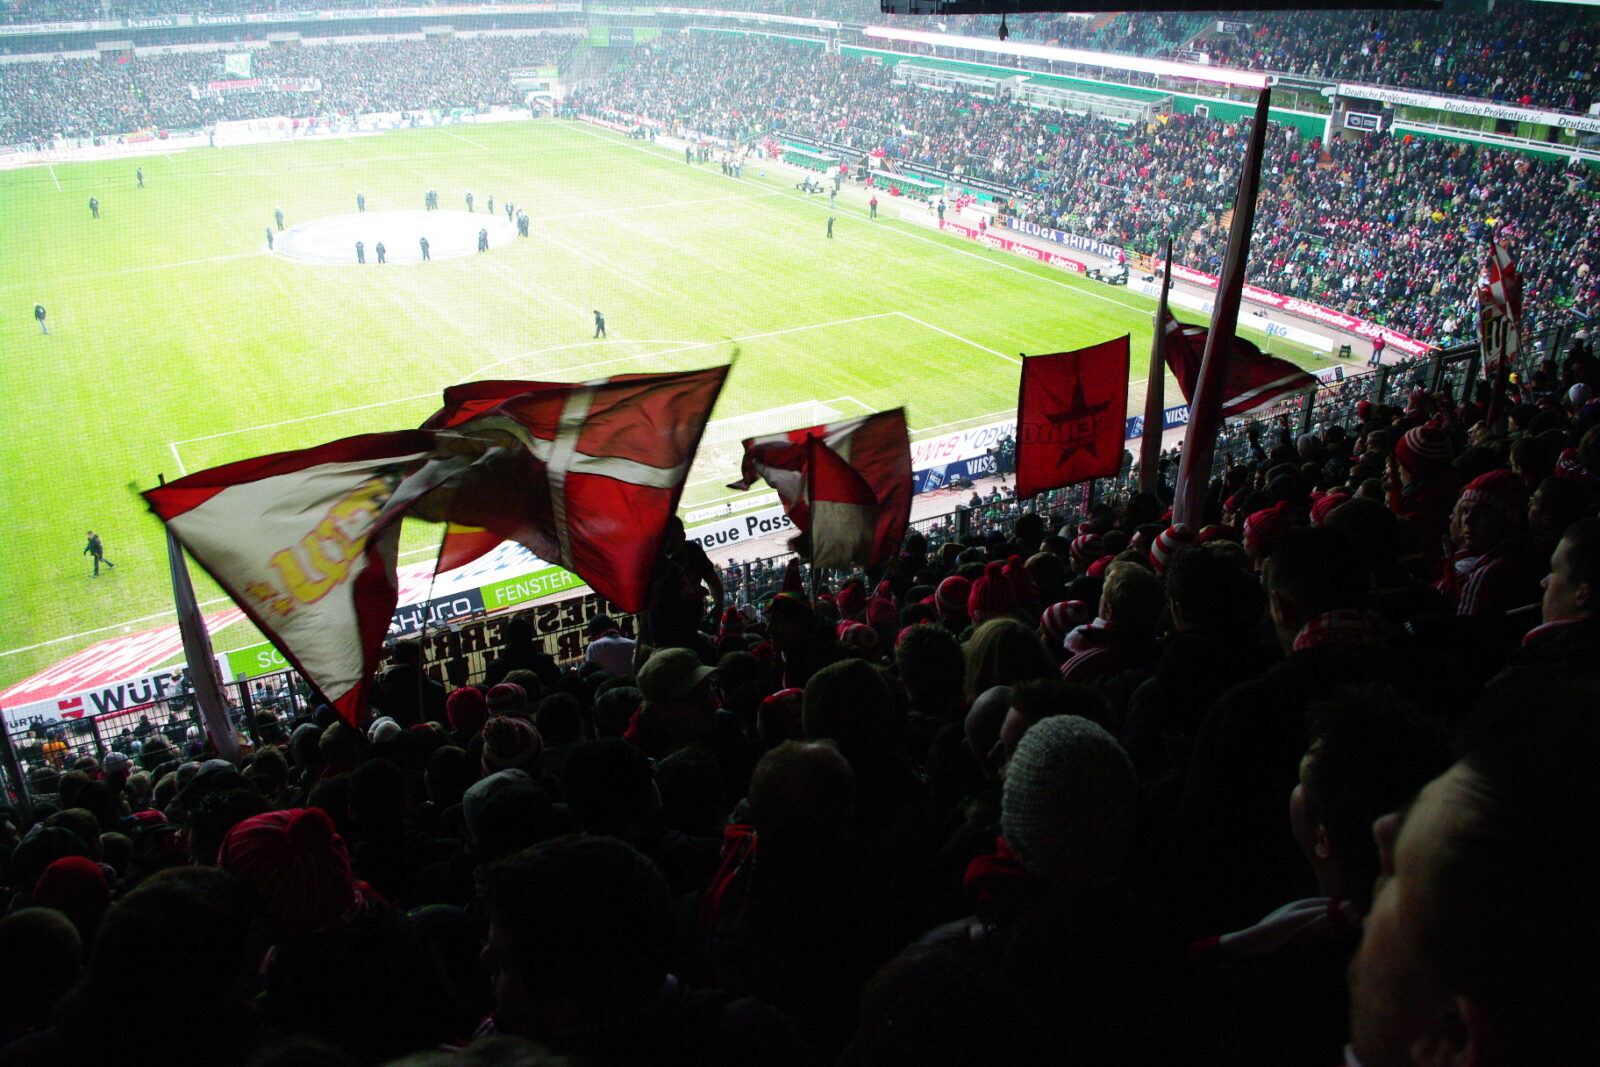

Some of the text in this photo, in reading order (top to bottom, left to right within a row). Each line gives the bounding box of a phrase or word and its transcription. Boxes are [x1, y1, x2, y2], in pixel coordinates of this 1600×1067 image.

[1344, 87, 1379, 99] Deutsche
[1379, 91, 1418, 105] ProVentus
[1444, 101, 1482, 115] Deutsche
[1483, 106, 1528, 121] ProVentus
[1558, 117, 1600, 132] Deutsche
[1012, 216, 1121, 260] BELUGA SHIPPING
[1011, 242, 1039, 260] Adecco
[1048, 253, 1079, 272] Adecco
[1166, 407, 1189, 424] VILSA
[966, 455, 998, 476] VILSA
[745, 513, 791, 536] Pass
[495, 570, 573, 604] FENSTER
